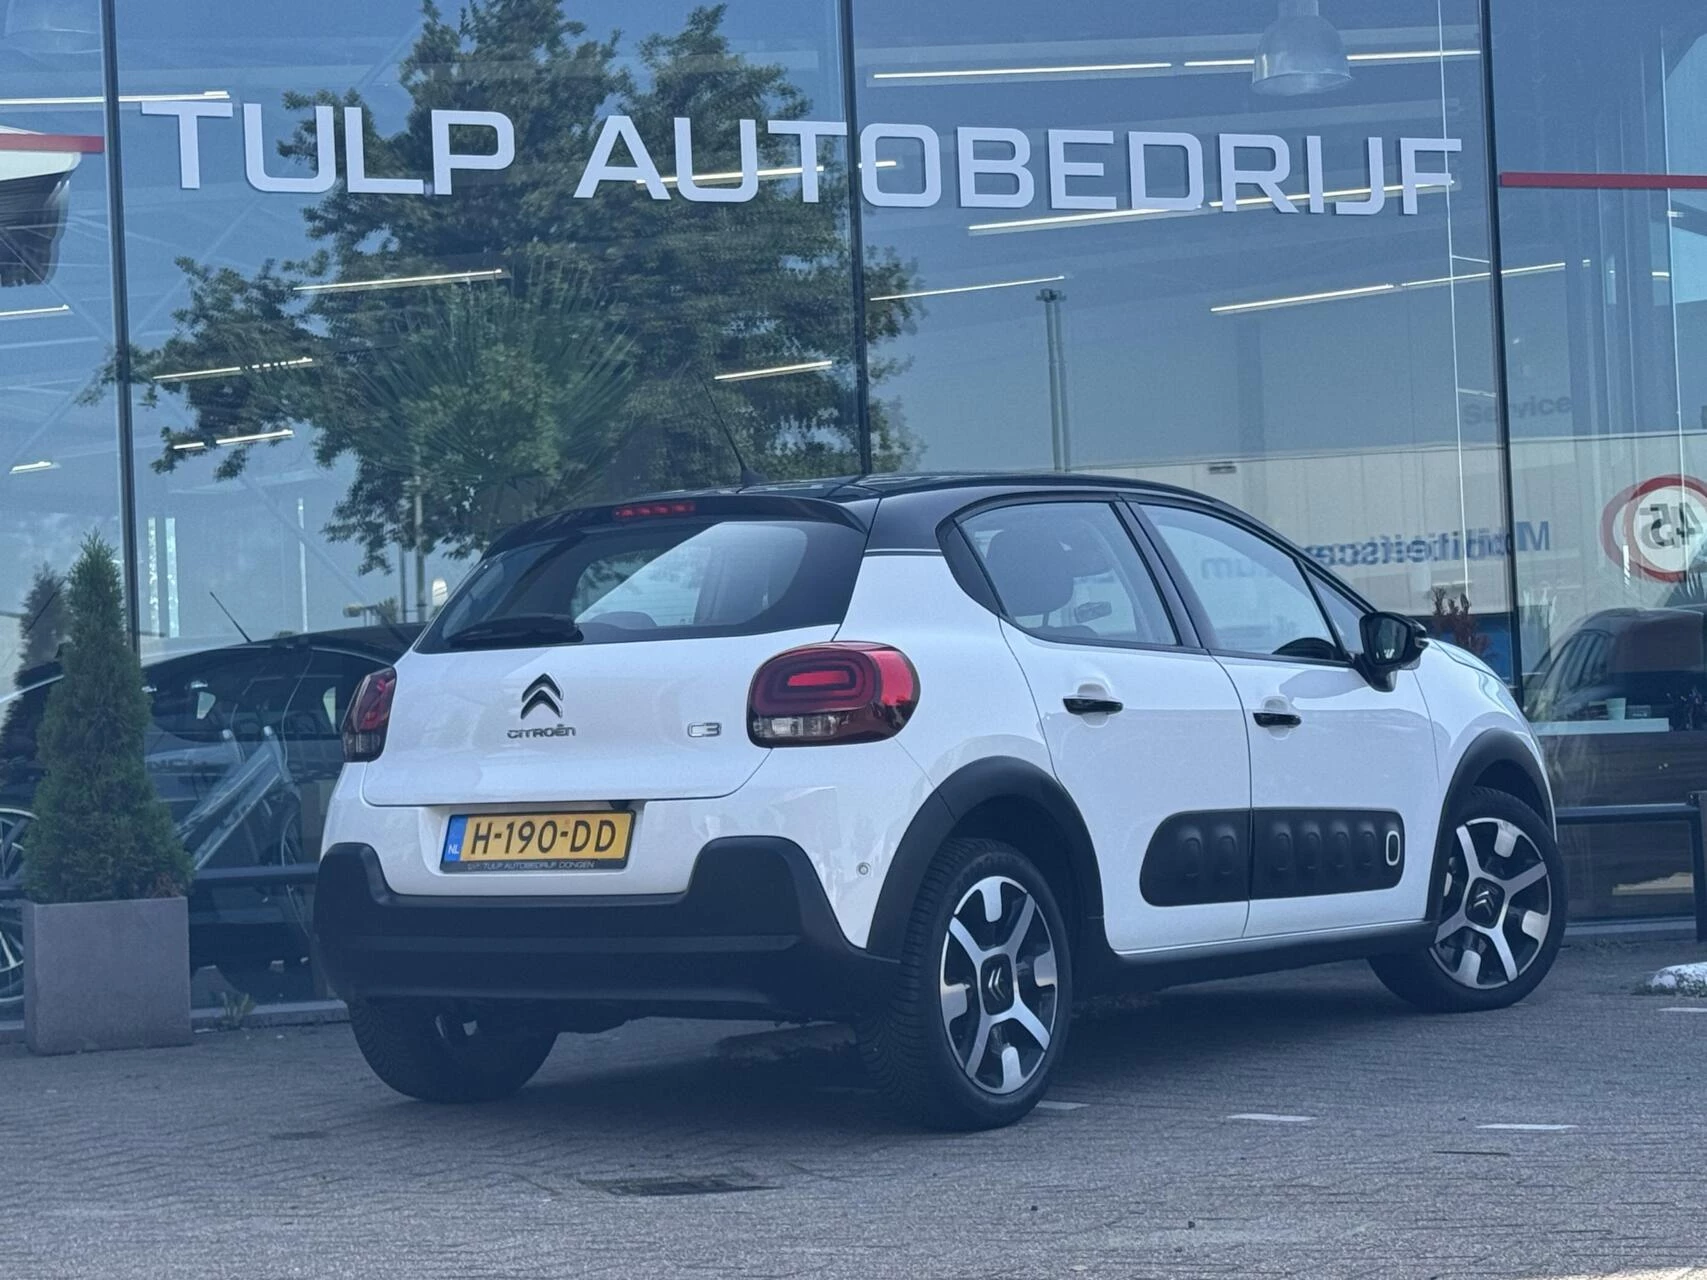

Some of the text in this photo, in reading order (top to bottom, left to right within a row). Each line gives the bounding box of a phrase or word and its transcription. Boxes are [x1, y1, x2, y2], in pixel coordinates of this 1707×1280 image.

[140, 101, 1463, 216] TULP AUTOBEDRIJF
[1463, 395, 1573, 425] Sevice
[687, 722, 722, 738] C3
[447, 845, 460, 855] NL
[470, 819, 617, 856] H-190-DD
